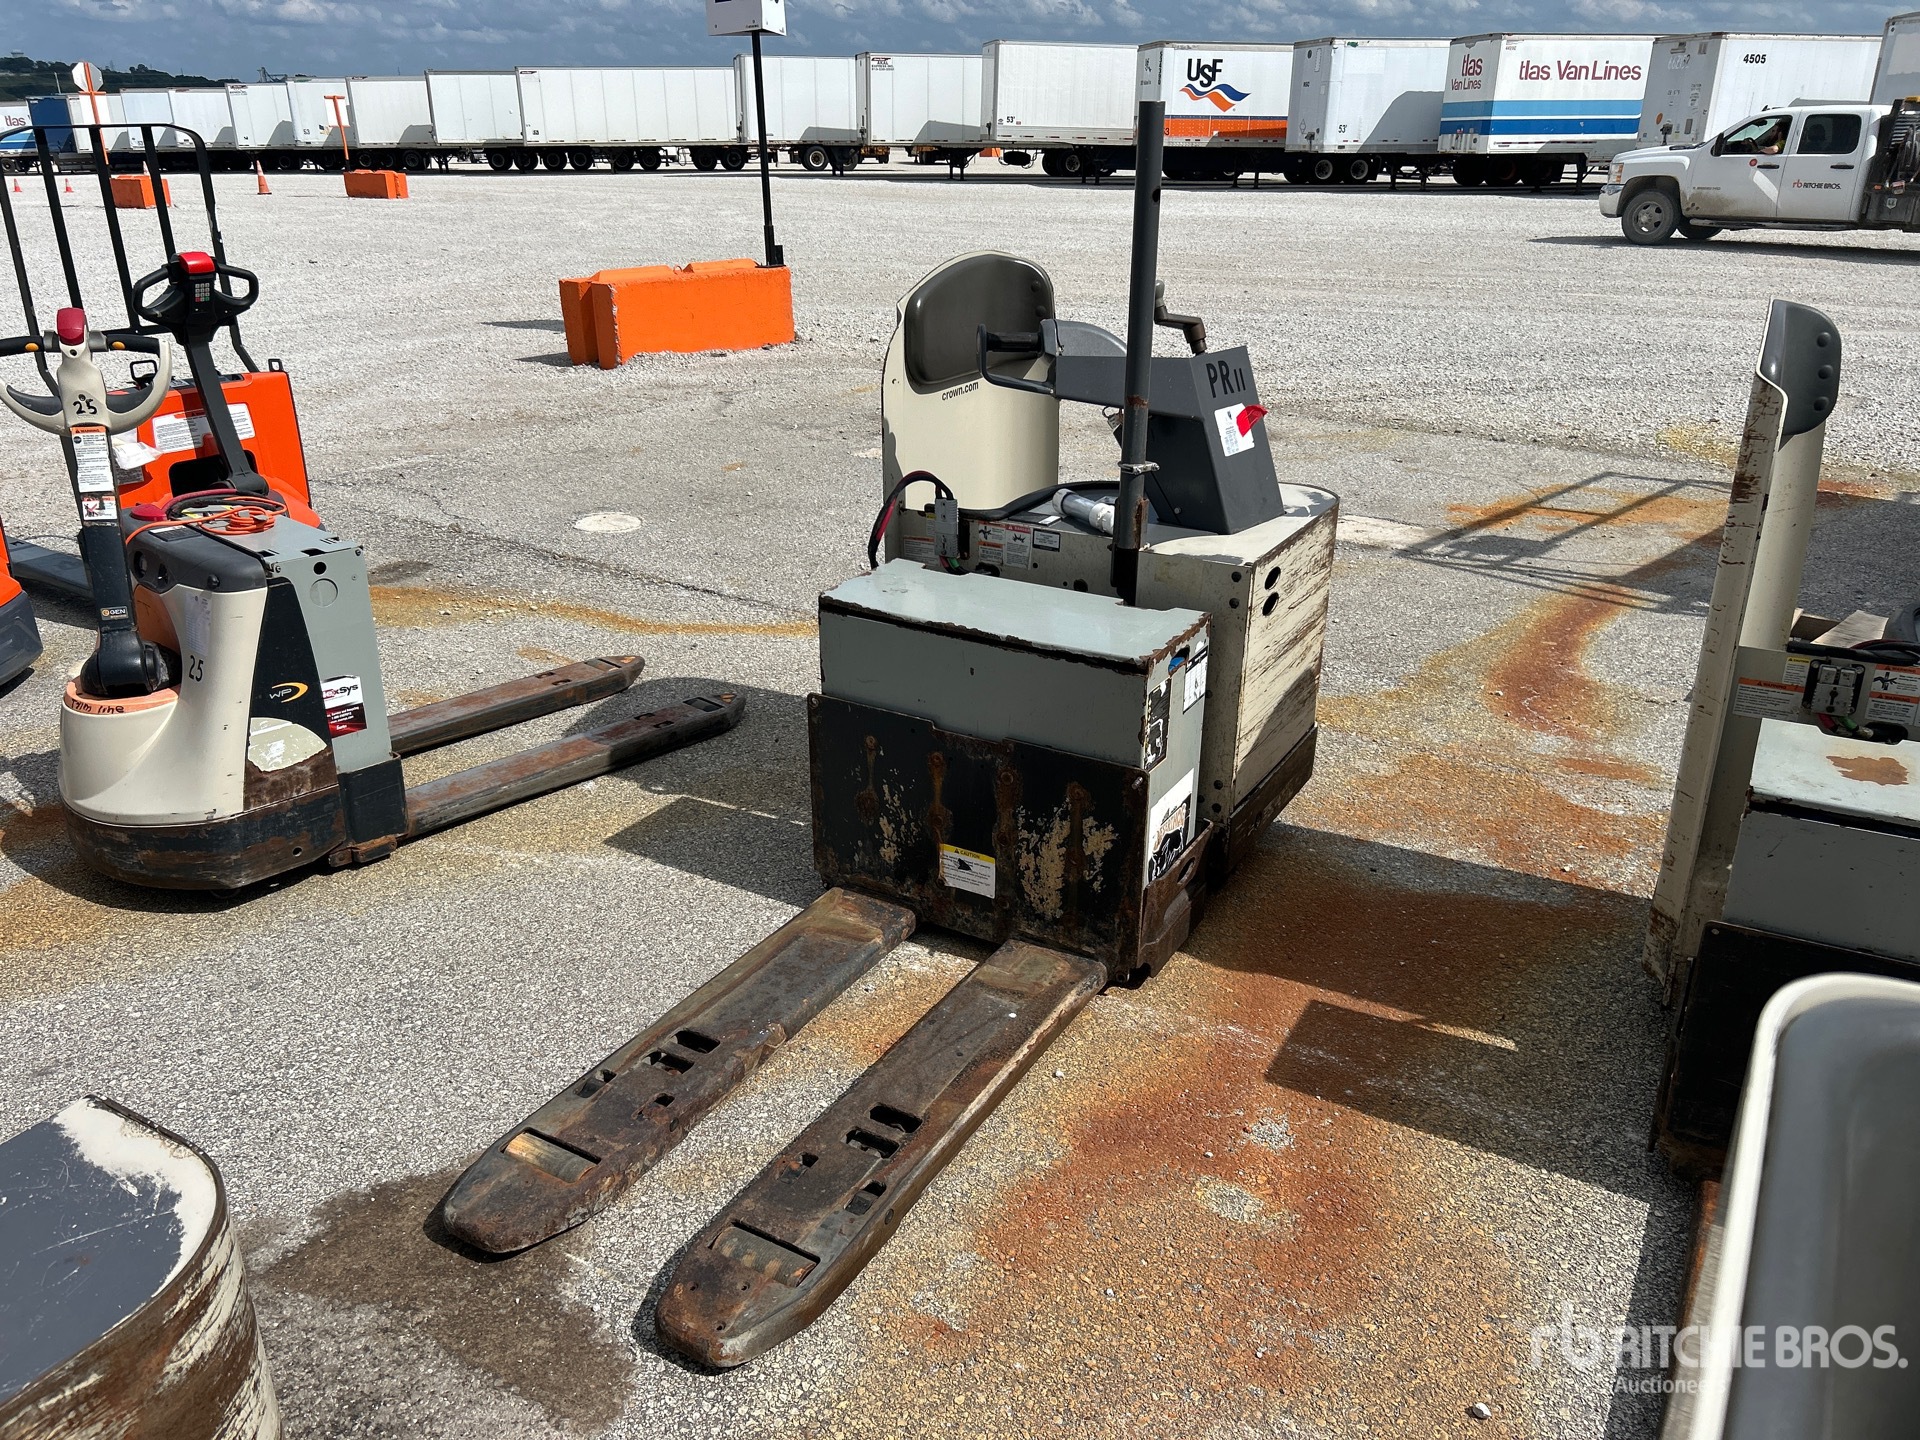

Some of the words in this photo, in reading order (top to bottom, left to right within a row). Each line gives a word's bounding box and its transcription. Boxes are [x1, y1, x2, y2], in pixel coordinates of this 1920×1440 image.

[1743, 54, 1767, 64] 4505
[1187, 58, 1224, 88] USF
[1519, 60, 1551, 81] tlas
[1557, 60, 1590, 81] Van
[1591, 60, 1642, 81] Lines
[1451, 78, 1463, 91] Van
[1463, 78, 1482, 90] Lines
[941, 381, 979, 401] crown.com
[72, 398, 98, 415] 25
[188, 654, 205, 682] 25
[269, 688, 293, 700] WP
